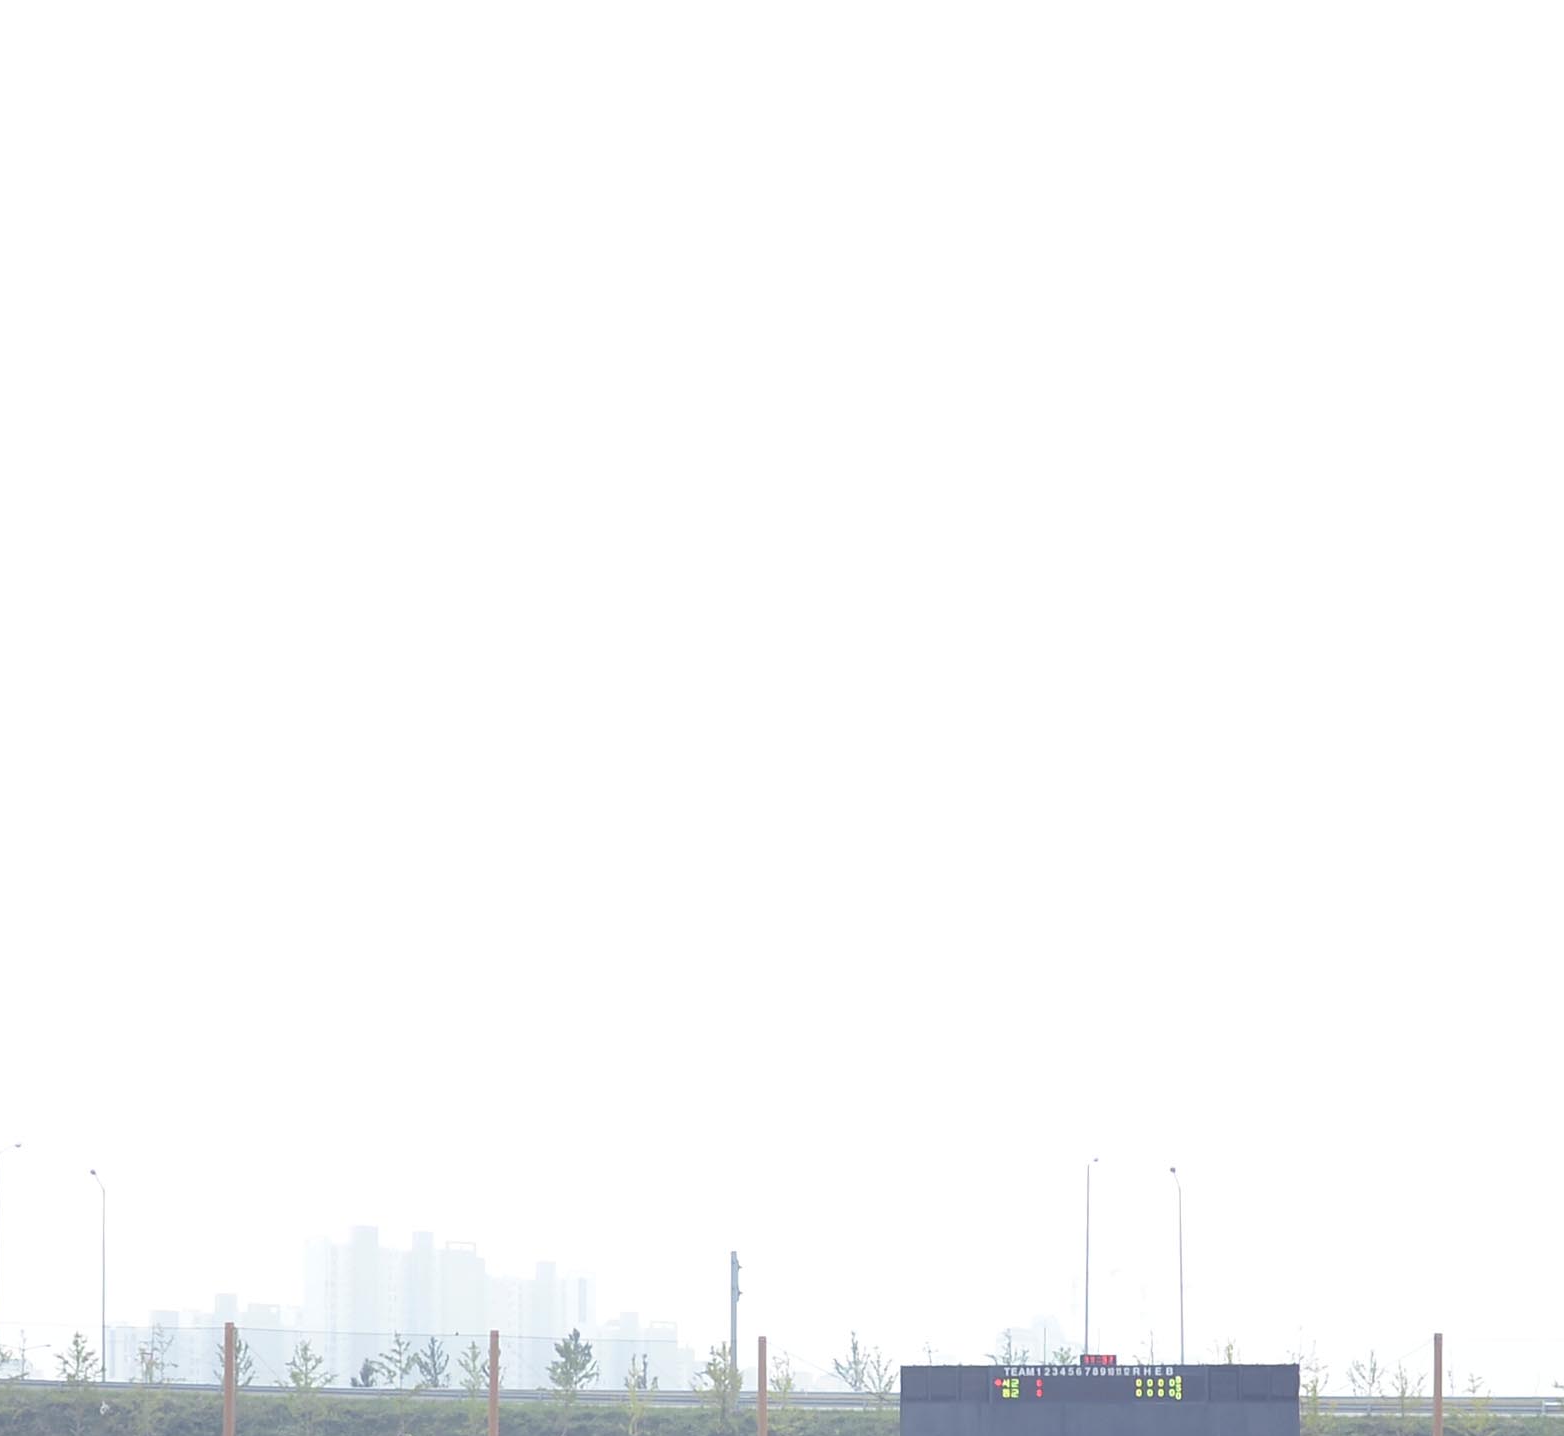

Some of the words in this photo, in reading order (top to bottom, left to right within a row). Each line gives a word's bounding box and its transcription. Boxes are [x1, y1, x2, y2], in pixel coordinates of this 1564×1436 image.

[1004, 1367, 1034, 1376] TEAM
[1037, 1367, 1041, 1376] 1
[1044, 1367, 1051, 1376] 2
[1052, 1367, 1058, 1376] 3
[1060, 1367, 1066, 1376] 4
[1068, 1367, 1074, 1376] 5
[1076, 1367, 1082, 1376] 6
[1085, 1367, 1091, 1376] 7
[1093, 1367, 1099, 1376] 8
[1100, 1367, 1106, 1376] 9
[1133, 1367, 1140, 1376] R
[1144, 1367, 1151, 1376] H
[1155, 1367, 1162, 1376] E
[1166, 1367, 1173, 1376] B
